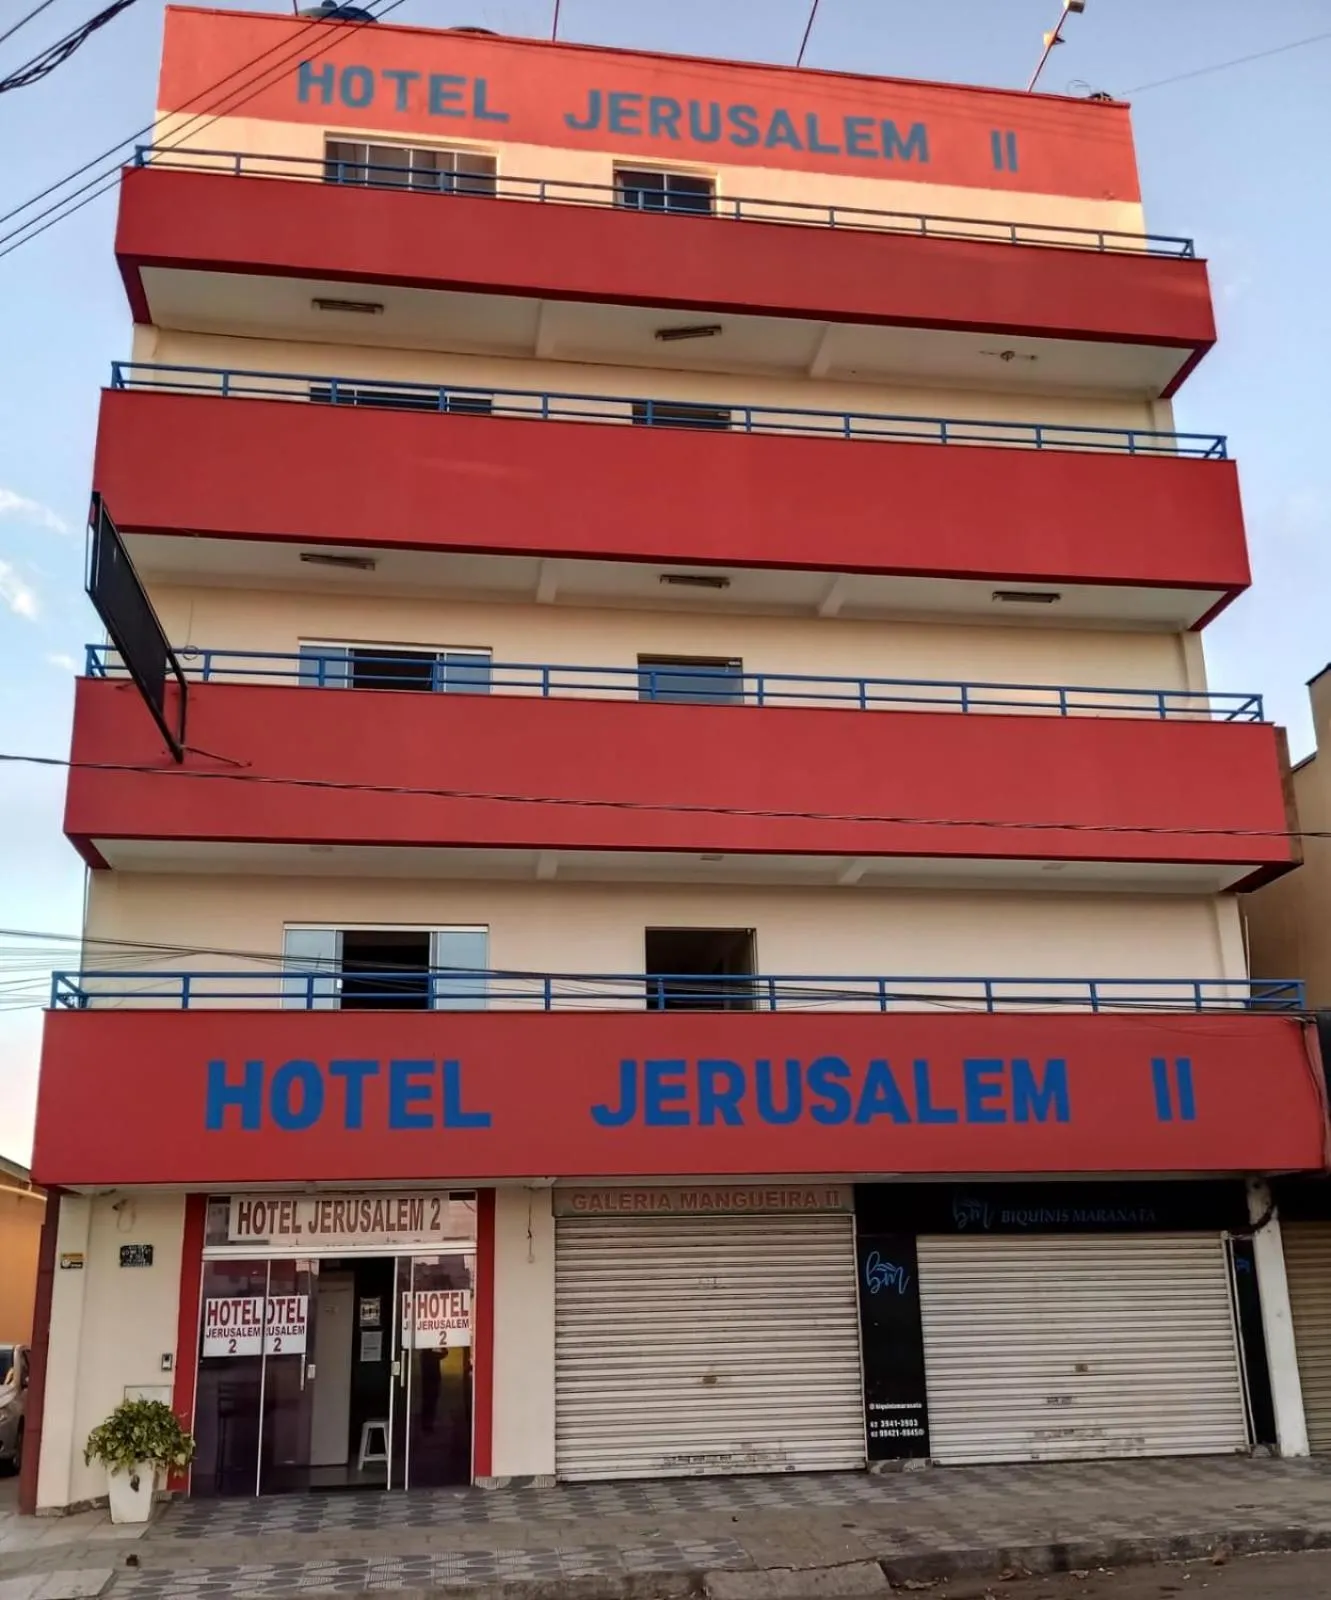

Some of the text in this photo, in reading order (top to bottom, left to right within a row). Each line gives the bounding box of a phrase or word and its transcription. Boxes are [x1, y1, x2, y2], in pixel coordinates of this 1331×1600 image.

[297, 61, 1018, 171] HOTEL JERUSALEM II
[205, 1055, 1197, 1131] HOTEL JERUSALEM II
[571, 1192, 672, 1213] GALERIA
[680, 1189, 821, 1210] MANGUEIRA
[237, 1197, 442, 1235] HOTEL JERUSALEM 2
[206, 1300, 261, 1327] HOTEL
[417, 1292, 469, 1319] HOTEL
[206, 1326, 261, 1339] JERUSALEM
[416, 1319, 470, 1331] JERUSALEM
[228, 1339, 237, 1354] 2
[273, 1337, 282, 1352] 2
[439, 1330, 448, 1345] 2
